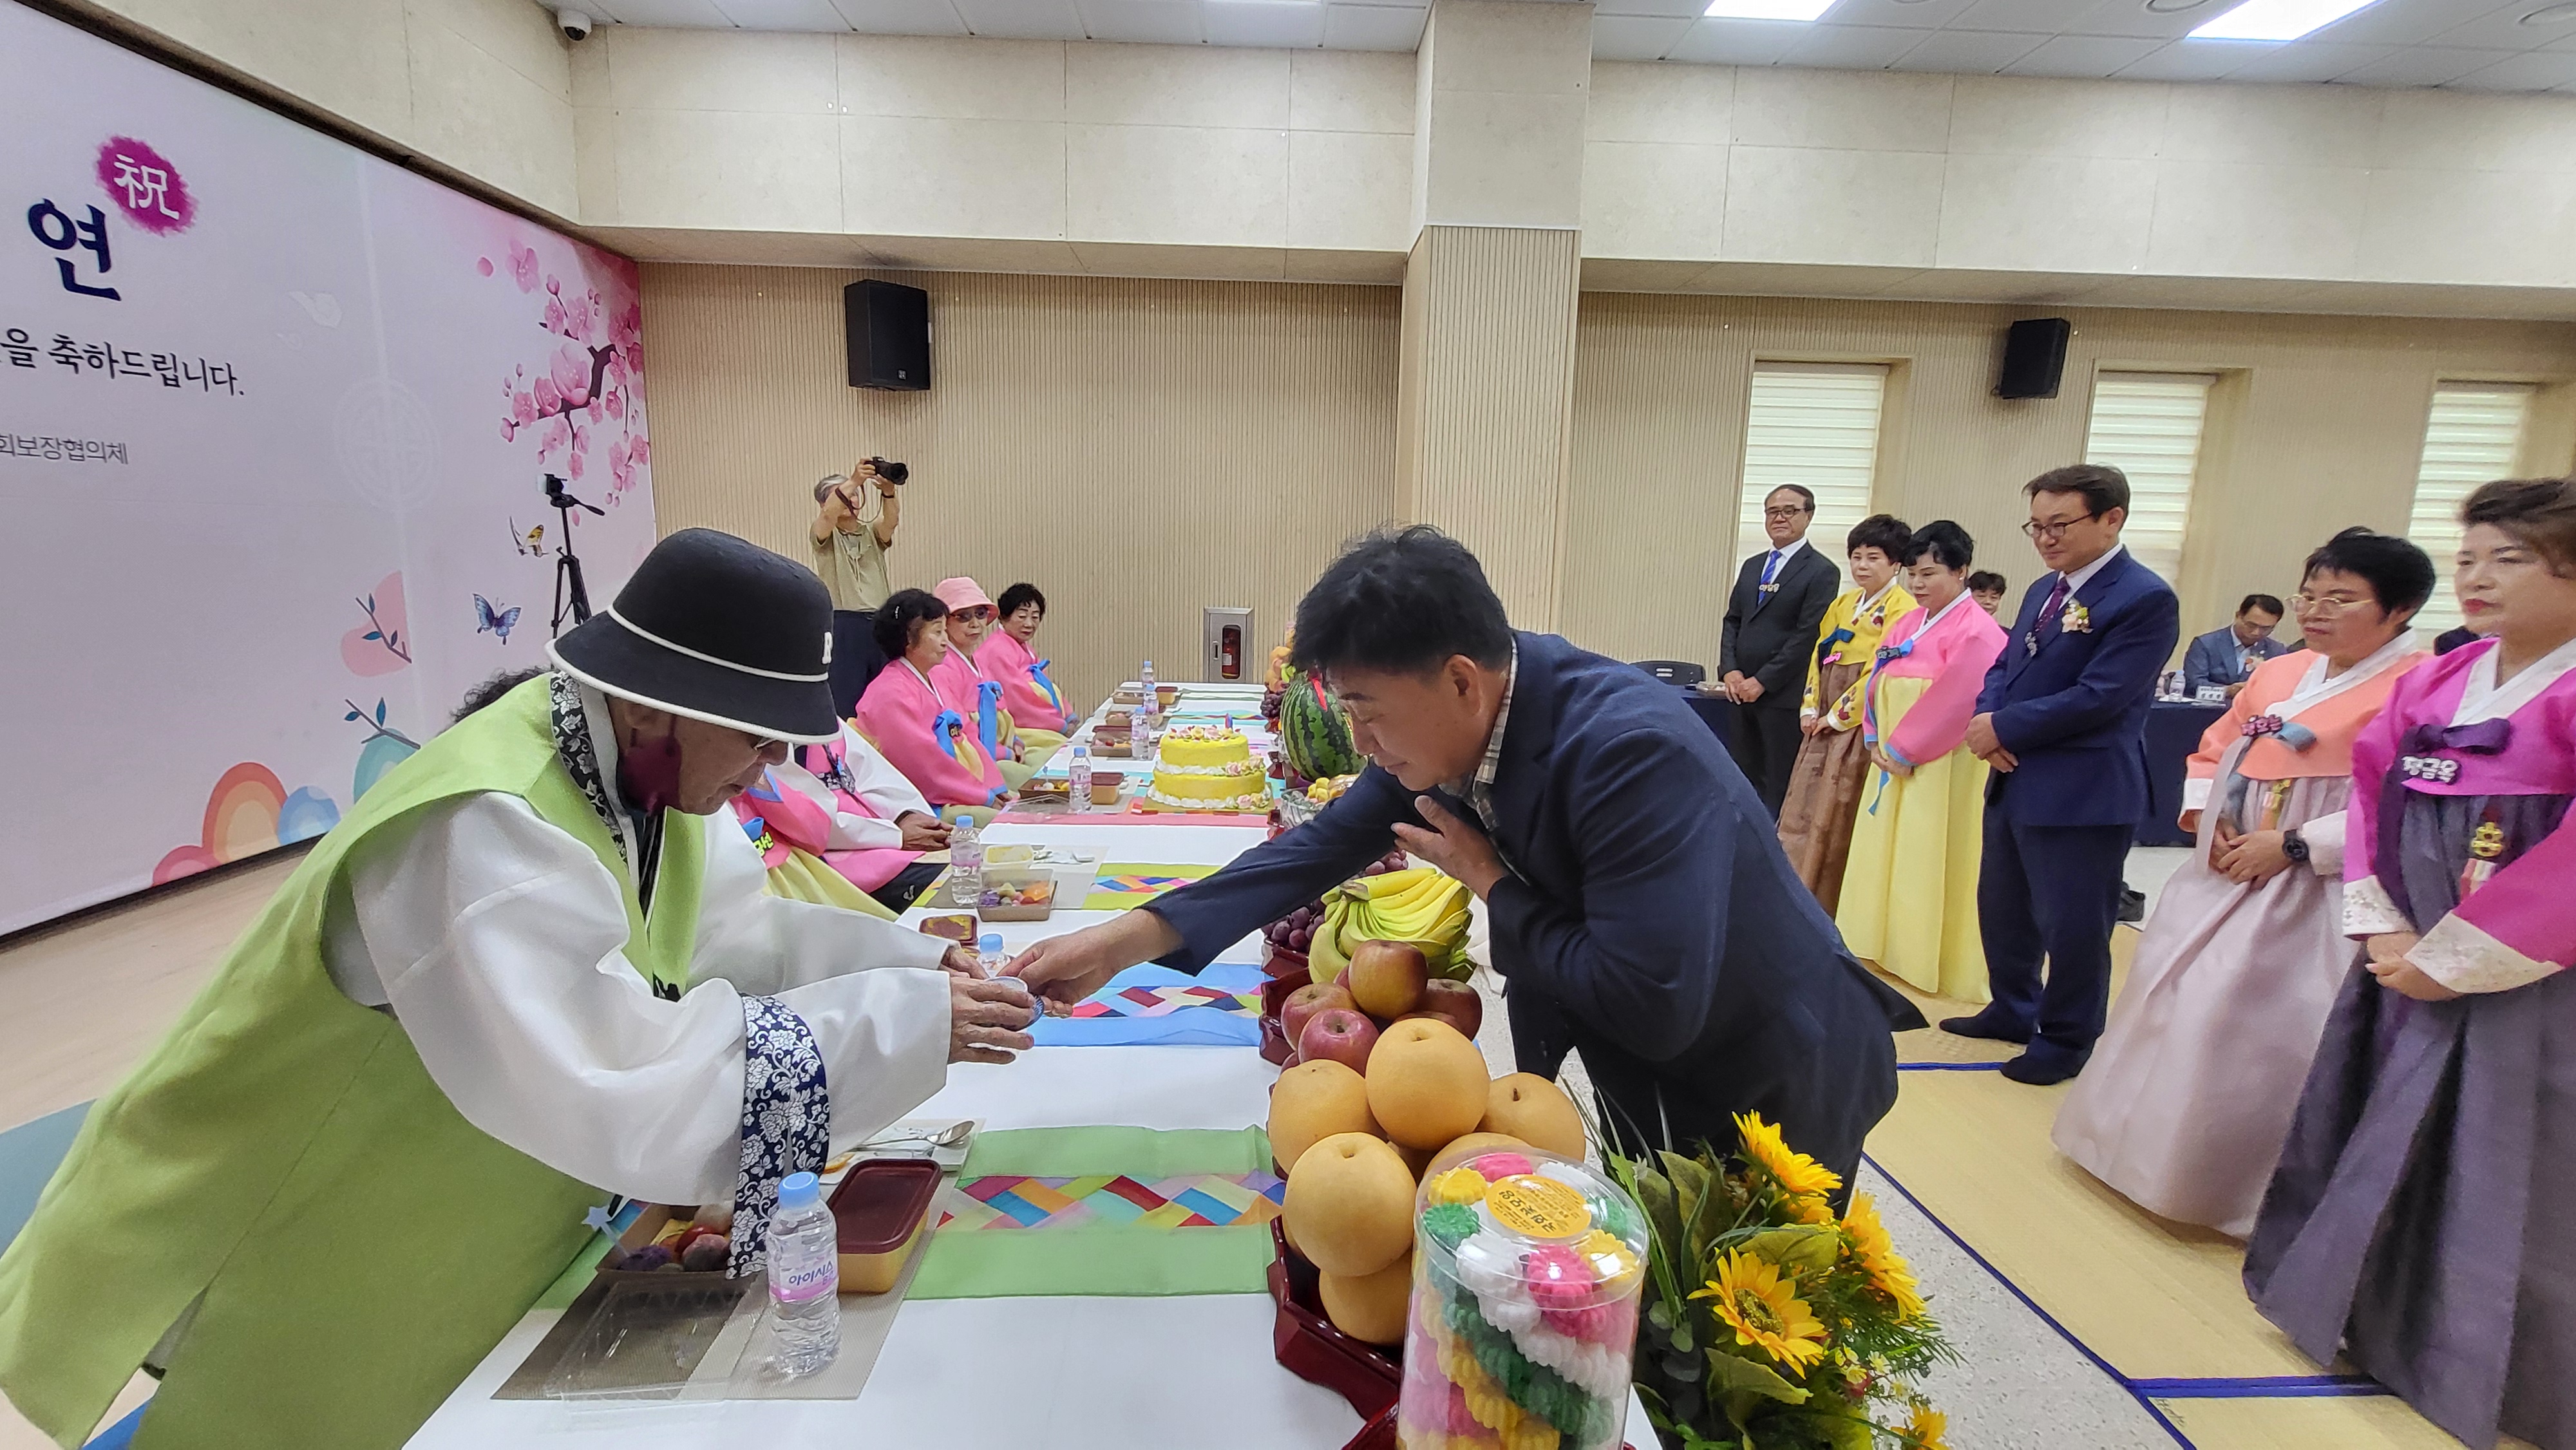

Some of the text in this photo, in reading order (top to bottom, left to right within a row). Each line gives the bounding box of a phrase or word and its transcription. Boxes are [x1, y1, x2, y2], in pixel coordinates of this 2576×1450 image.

[114, 154, 180, 220] 祝
[28, 198, 121, 301] 연
[47, 333, 245, 396] 축하드립니다.
[0, 433, 128, 465] 회보장협의체
